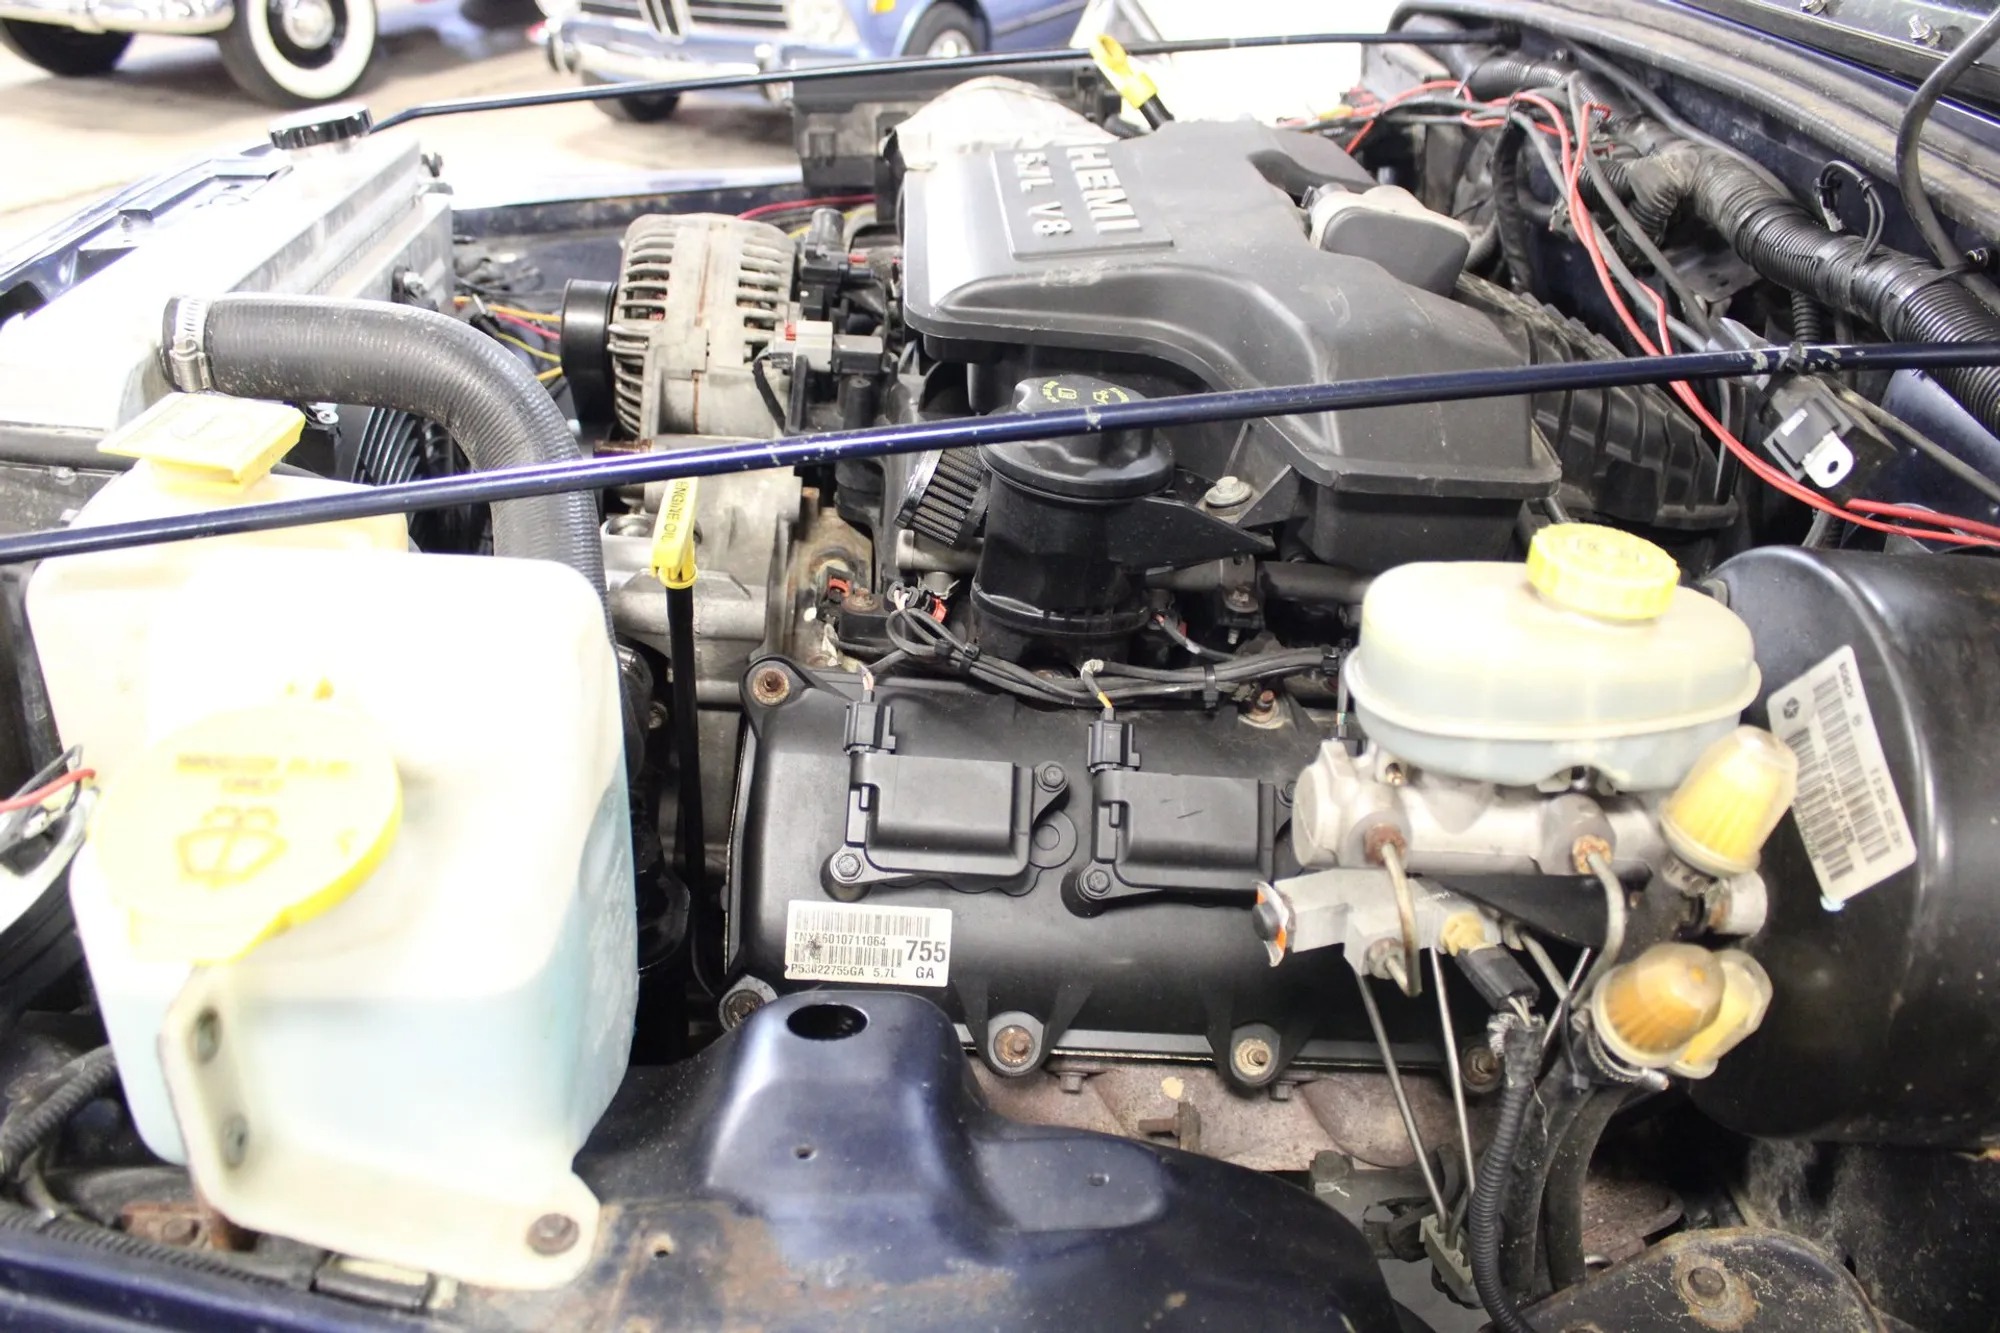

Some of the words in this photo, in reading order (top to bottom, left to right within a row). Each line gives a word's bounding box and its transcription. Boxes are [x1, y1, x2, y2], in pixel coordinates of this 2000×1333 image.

[1066, 147, 1142, 233] HEMI
[1027, 201, 1073, 236] V8
[666, 481, 689, 520] ENGINE
[661, 523, 677, 541] OIL
[905, 939, 947, 962] 755
[873, 967, 897, 978] 5.7L
[915, 966, 935, 979] GA
